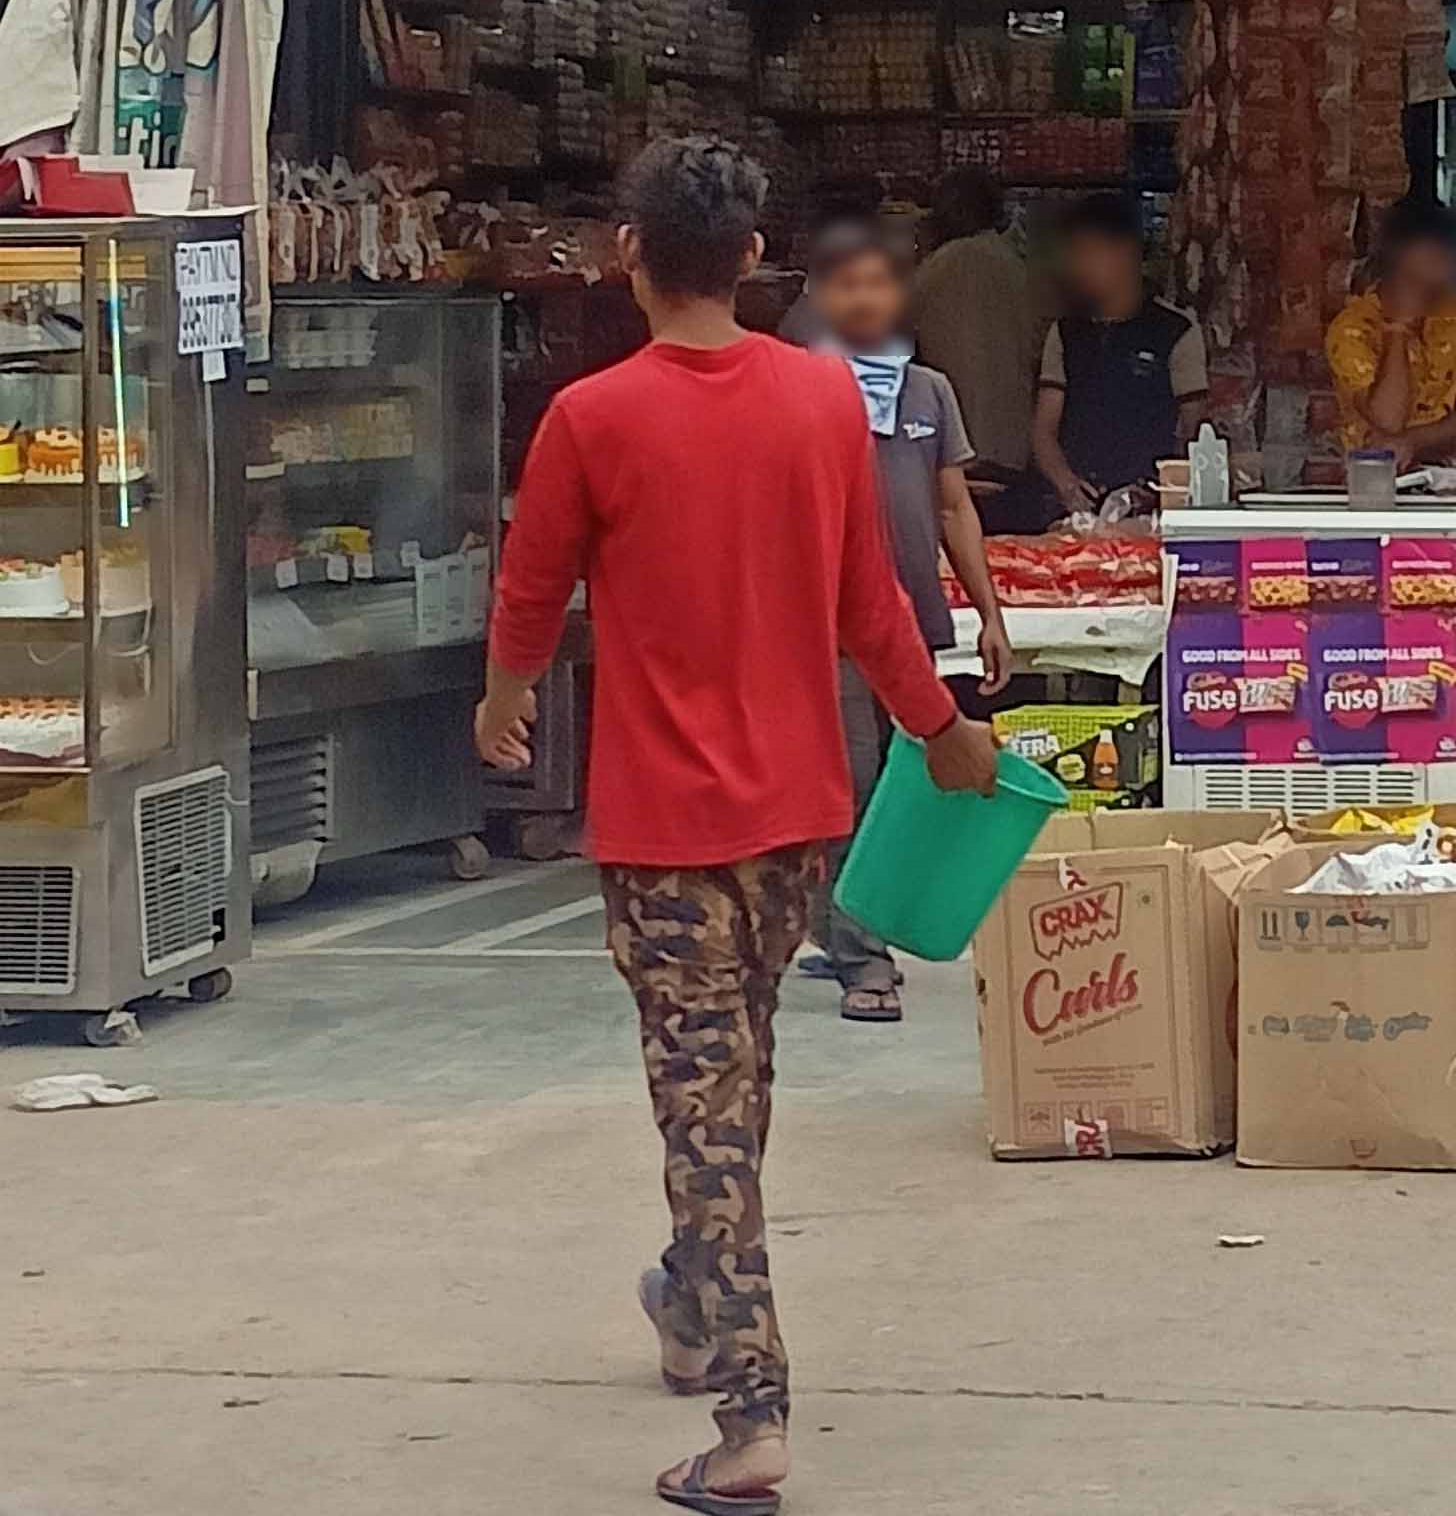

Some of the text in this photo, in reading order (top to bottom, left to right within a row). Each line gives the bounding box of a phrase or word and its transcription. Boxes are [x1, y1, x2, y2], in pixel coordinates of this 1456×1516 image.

[1181, 648, 1216, 663] GOOD
[1323, 647, 1357, 662] GOOD
[1039, 891, 1115, 937] CRAX
[1022, 952, 1139, 1035] Curls
